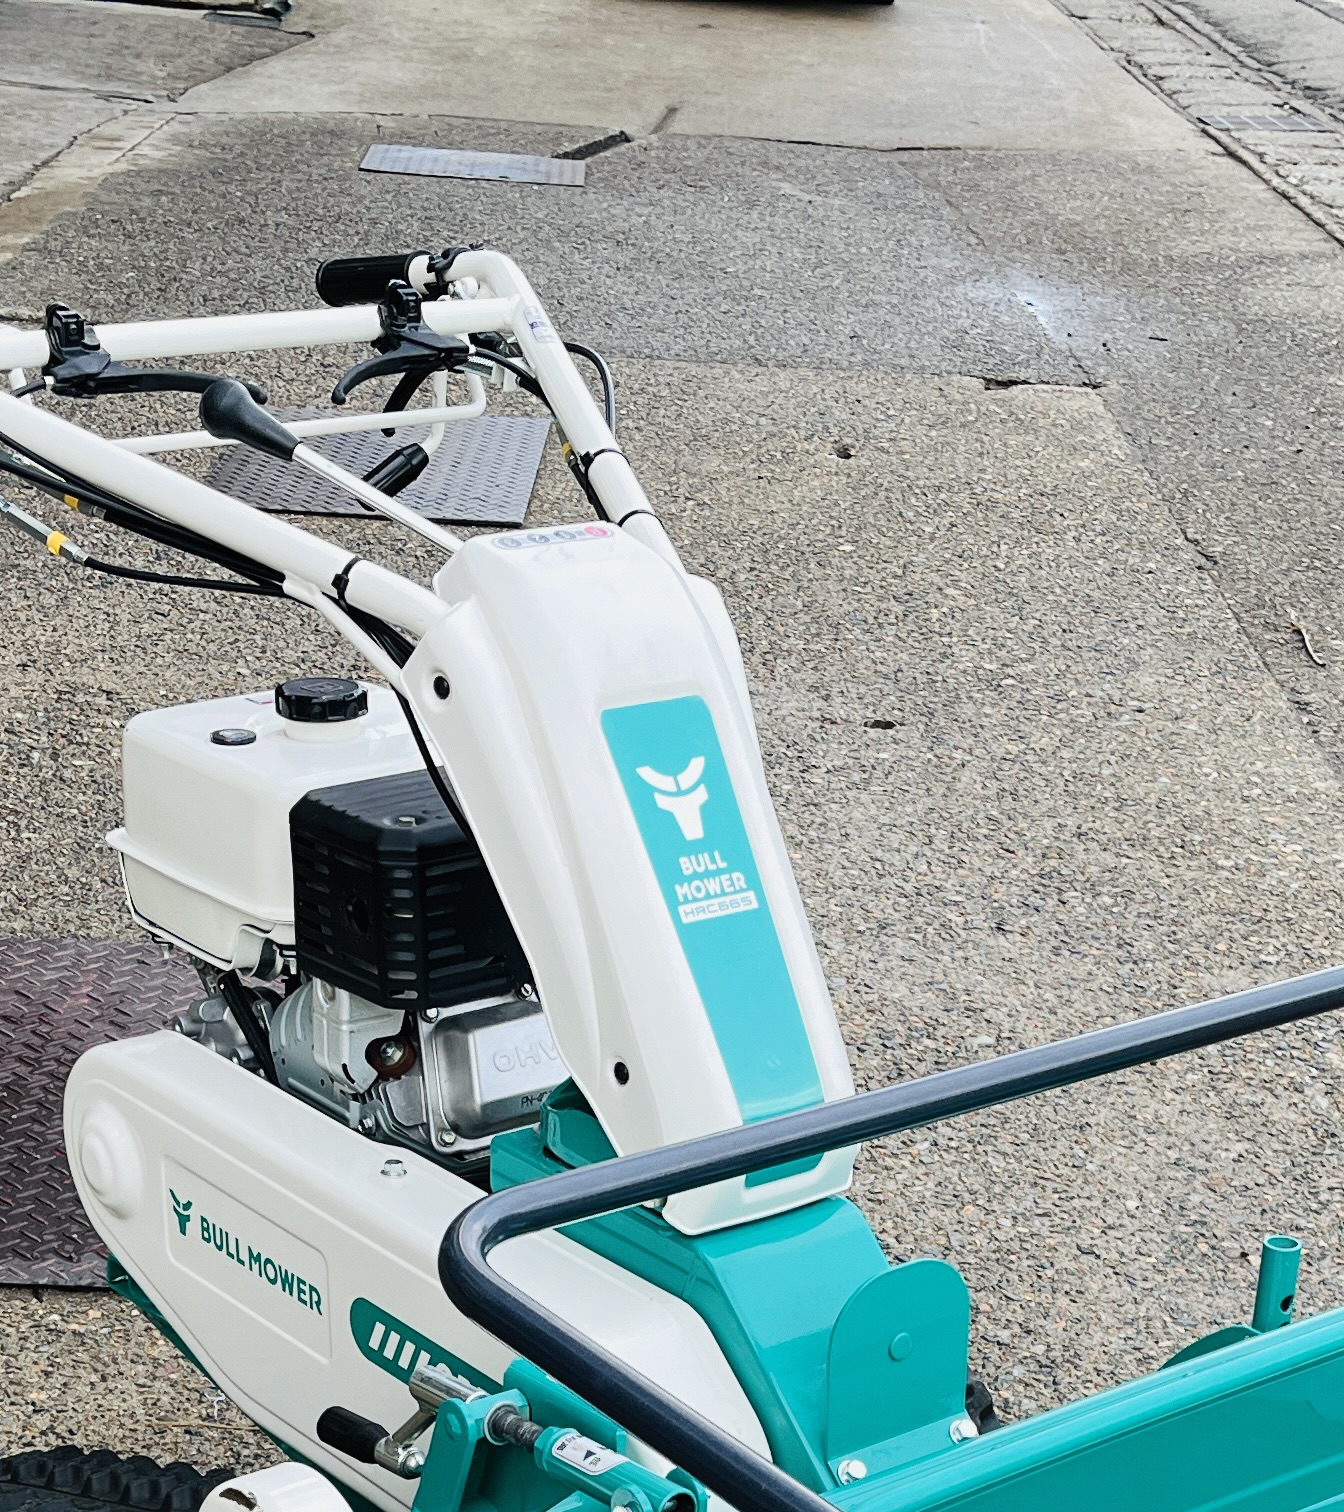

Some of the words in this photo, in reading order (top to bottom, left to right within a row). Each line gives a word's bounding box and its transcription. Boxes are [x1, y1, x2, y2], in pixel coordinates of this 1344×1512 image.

[678, 850, 728, 876] BULL
[674, 871, 748, 903] MOWER
[492, 1039, 558, 1073] OHV
[200, 1215, 246, 1267] BULL
[247, 1245, 323, 1316] MOWER
